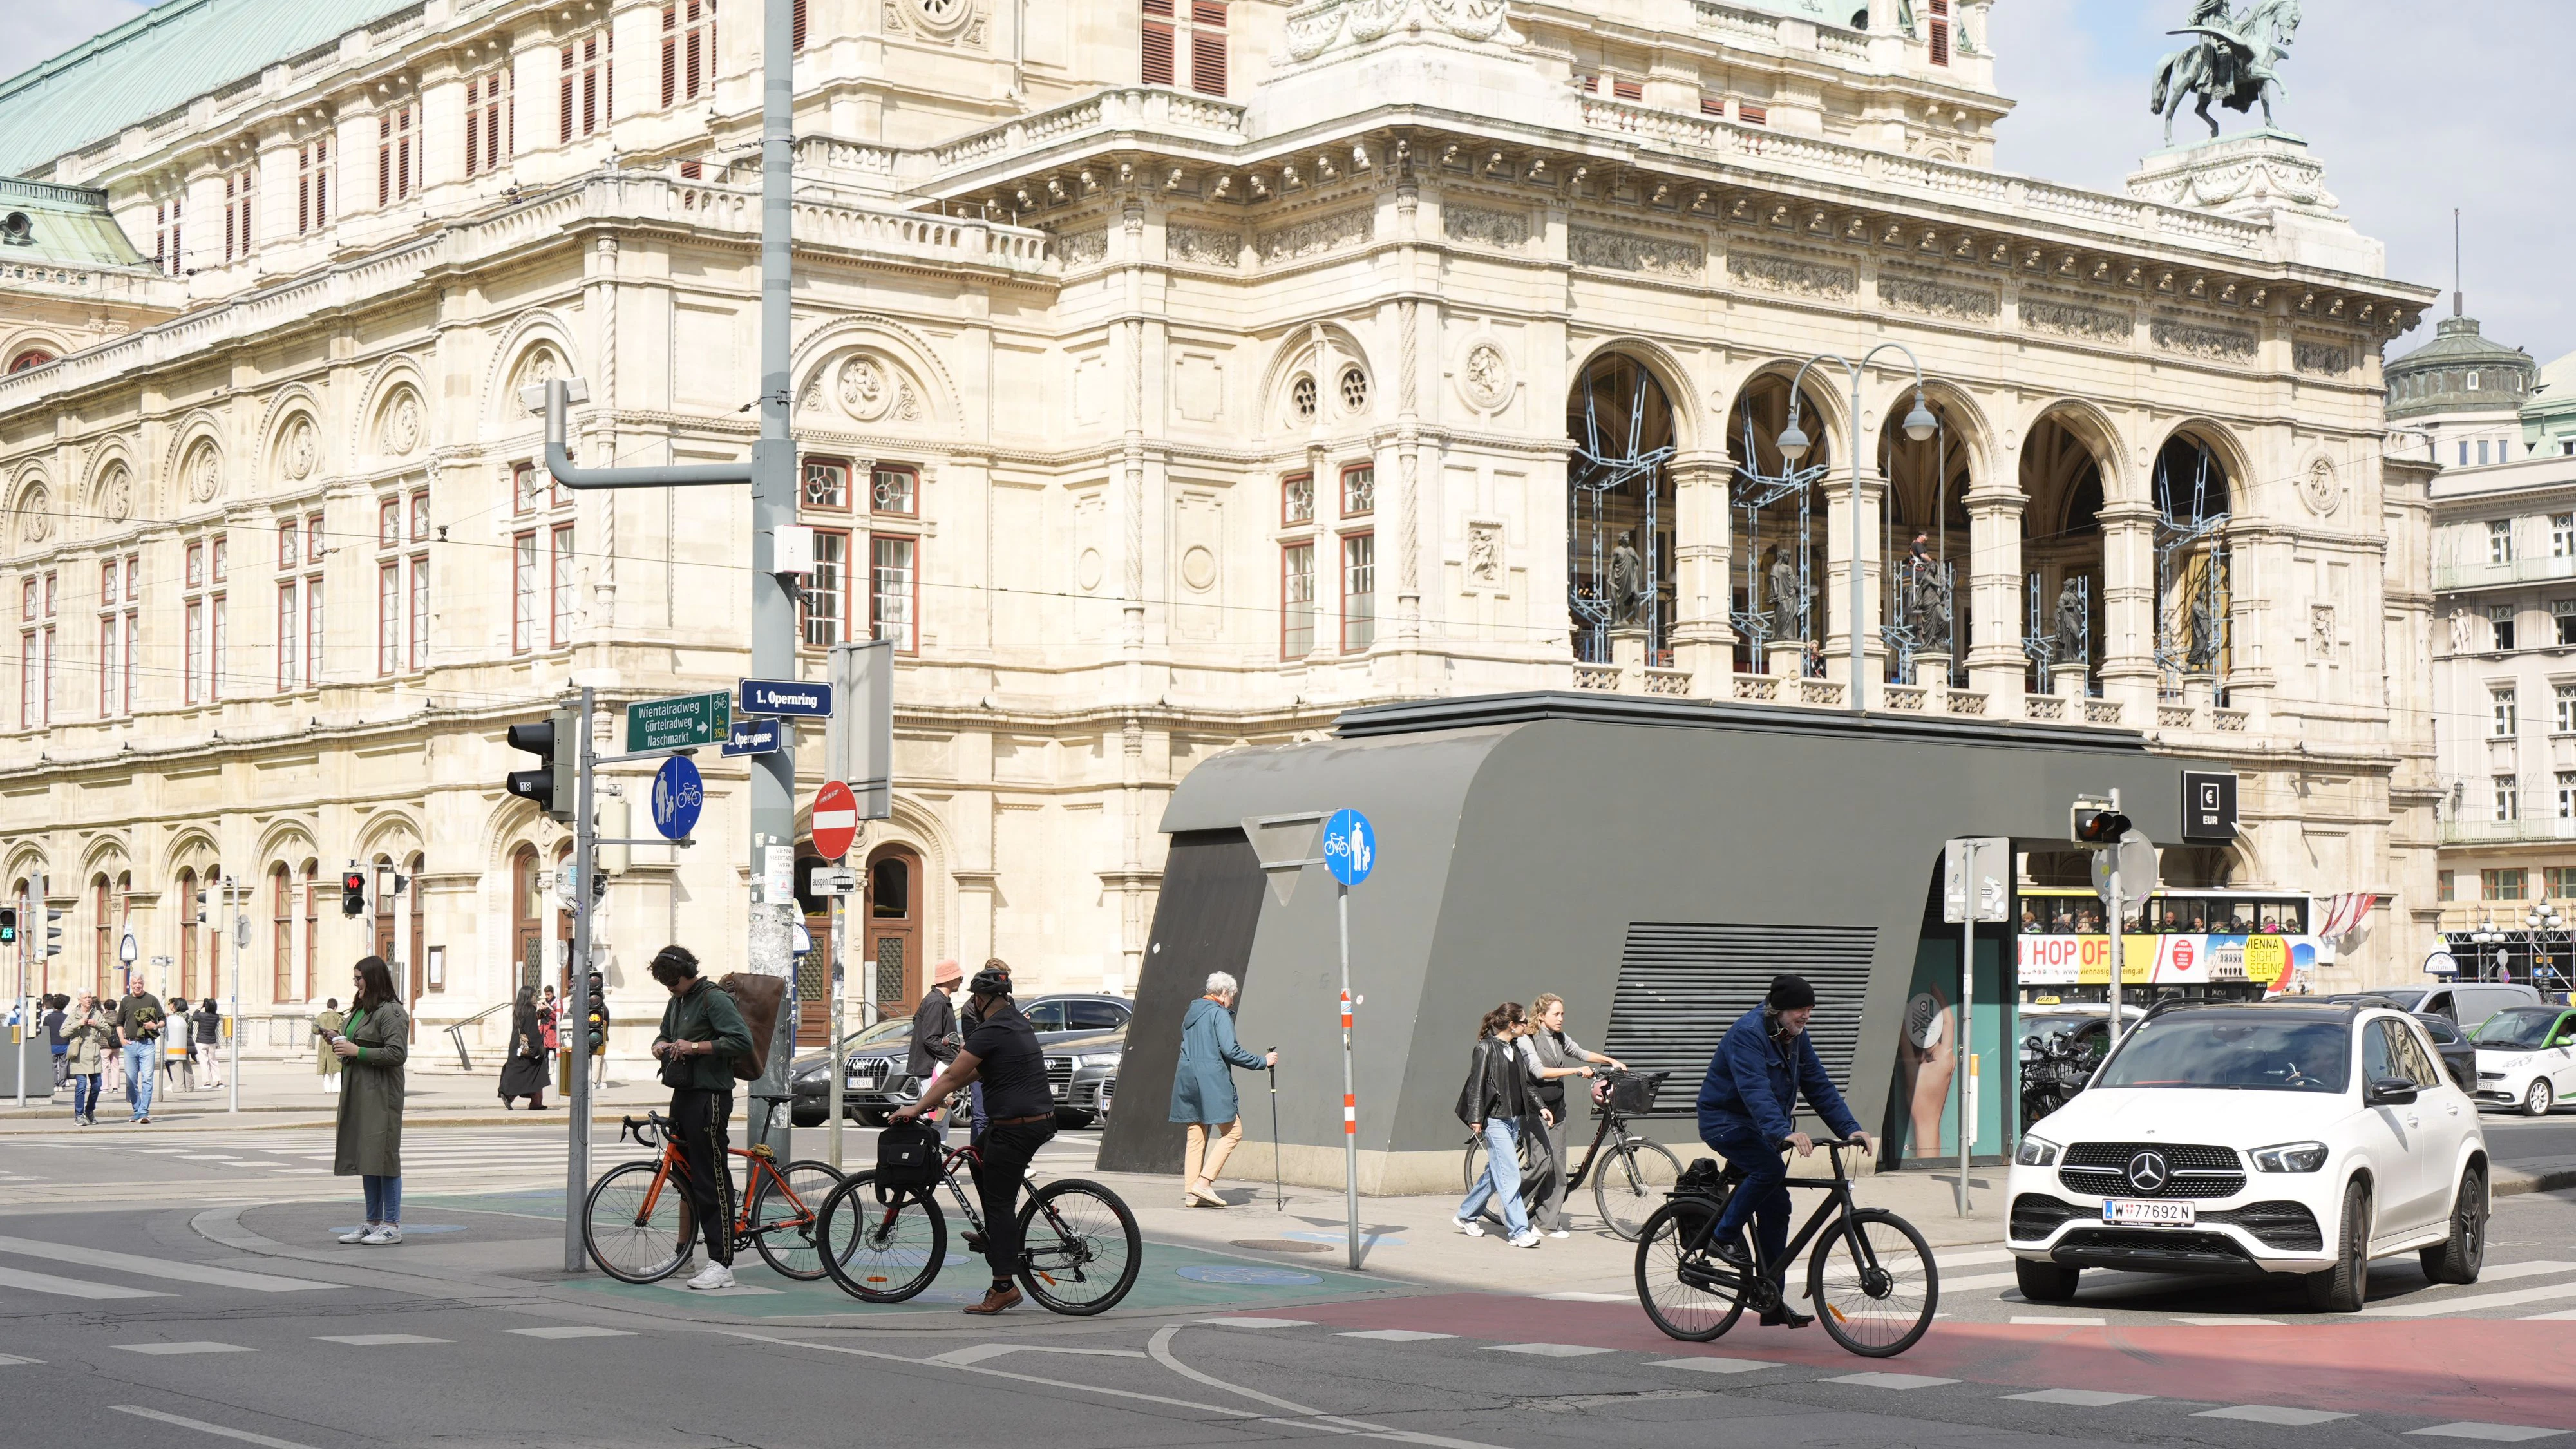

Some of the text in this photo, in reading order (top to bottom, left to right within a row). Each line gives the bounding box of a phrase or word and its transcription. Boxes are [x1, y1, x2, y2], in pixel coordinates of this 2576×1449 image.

[768, 690, 817, 709] Opernring
[638, 701, 700, 719] Wientalradweg
[645, 717, 693, 733] Gürtelradweg
[647, 733, 690, 747] Naschmarkt
[735, 732, 772, 749] Operngasse
[2205, 790, 2213, 804] €
[2202, 815, 2218, 825] EUR
[812, 878, 829, 889] ausgen.
[2246, 938, 2279, 950] VIENNA
[2033, 940, 2076, 965] HOP
[2082, 940, 2109, 965] OF
[2250, 951, 2277, 961] SIGHT
[2250, 963, 2284, 974] SEEING
